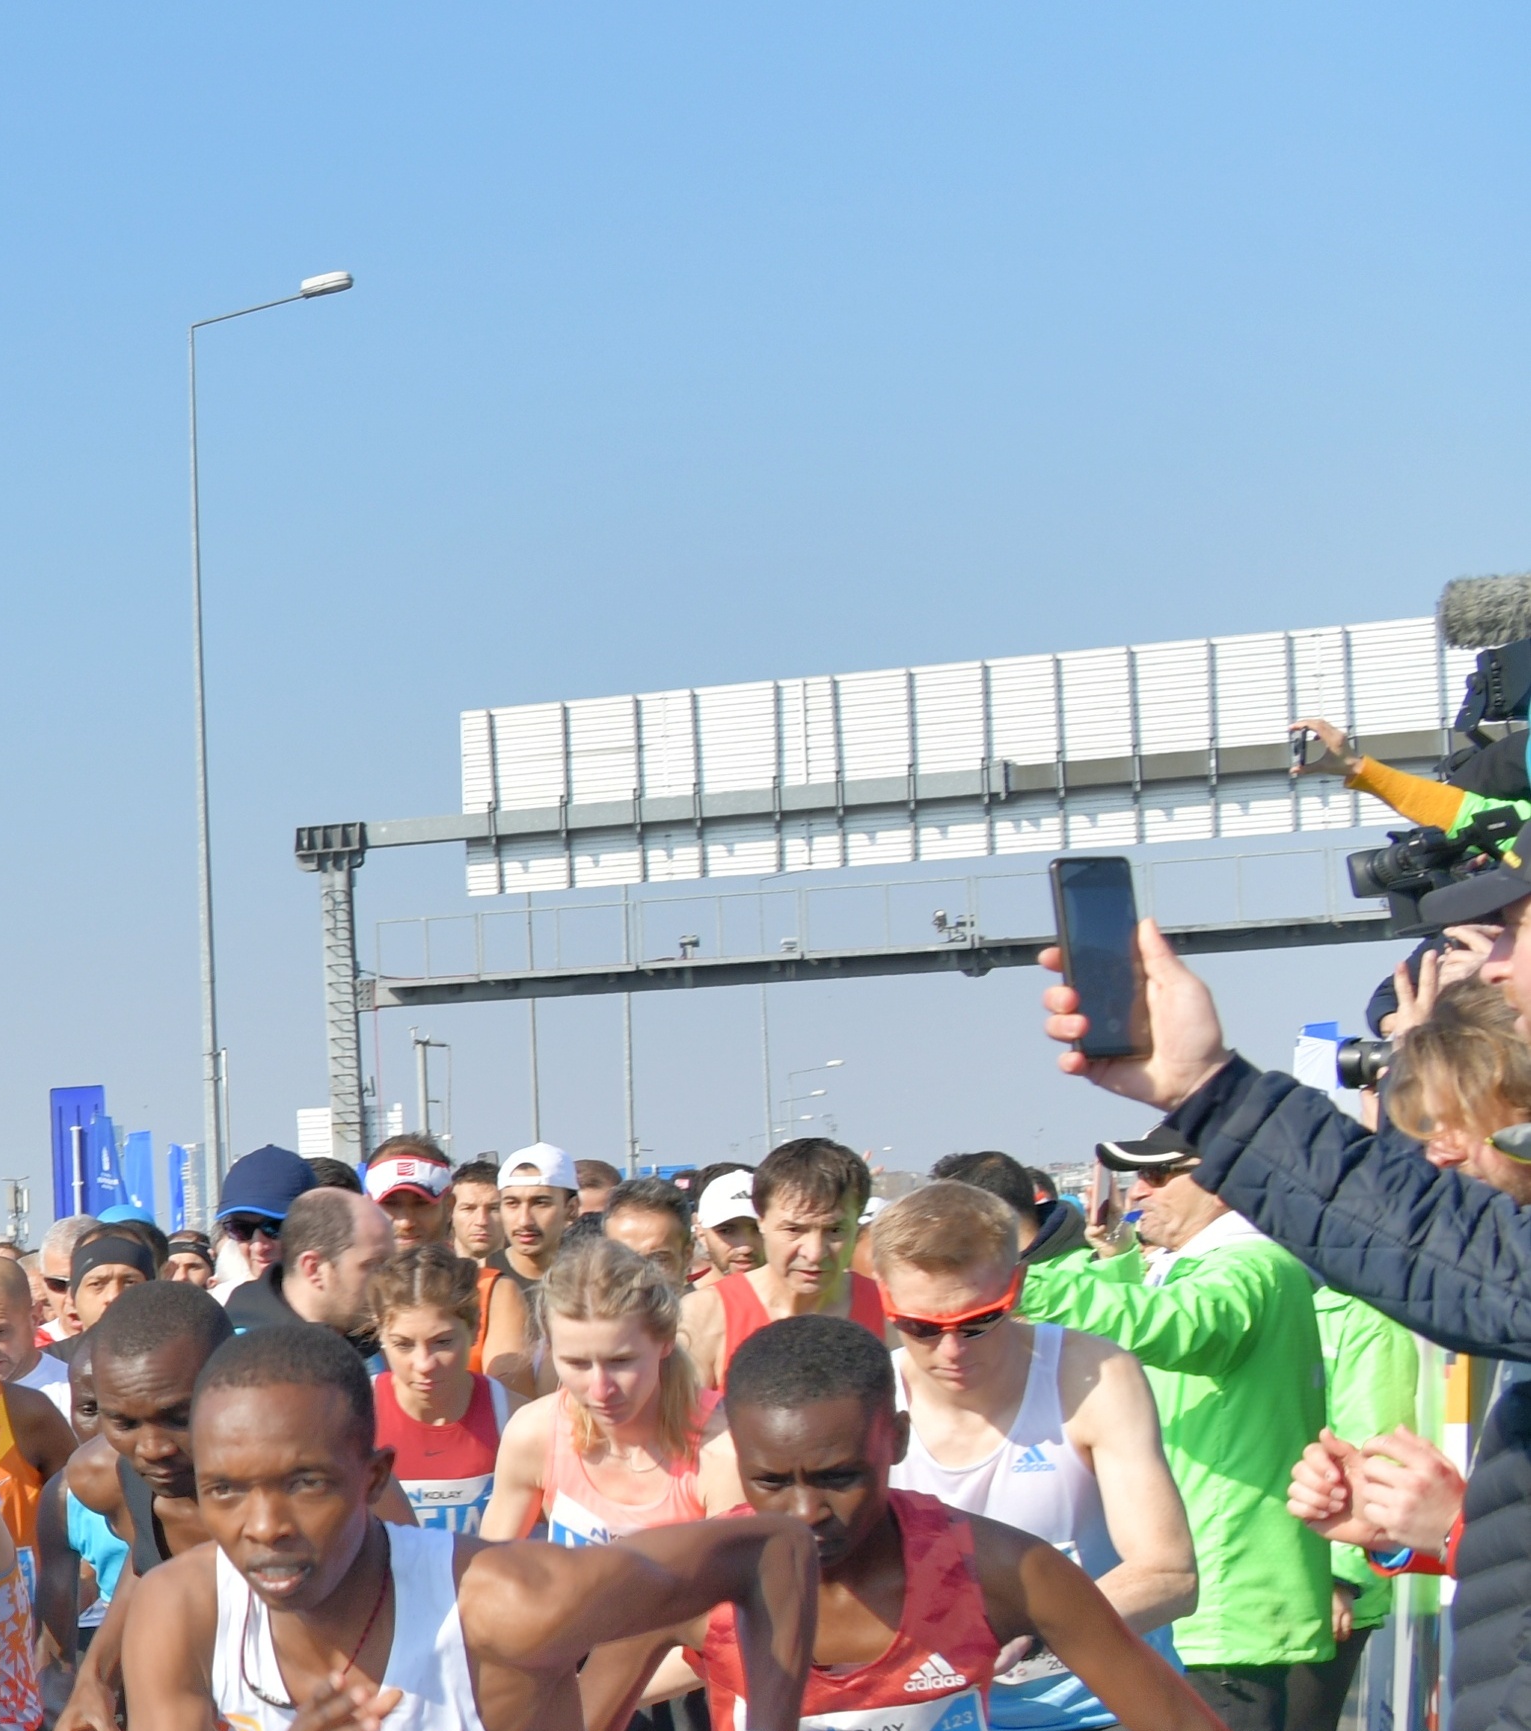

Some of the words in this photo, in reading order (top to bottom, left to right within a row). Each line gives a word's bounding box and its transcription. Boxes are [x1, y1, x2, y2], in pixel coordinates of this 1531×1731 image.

[1011, 1462, 1056, 1473] adidas
[903, 1670, 967, 1693] adidas
[941, 1710, 974, 1731] 123
